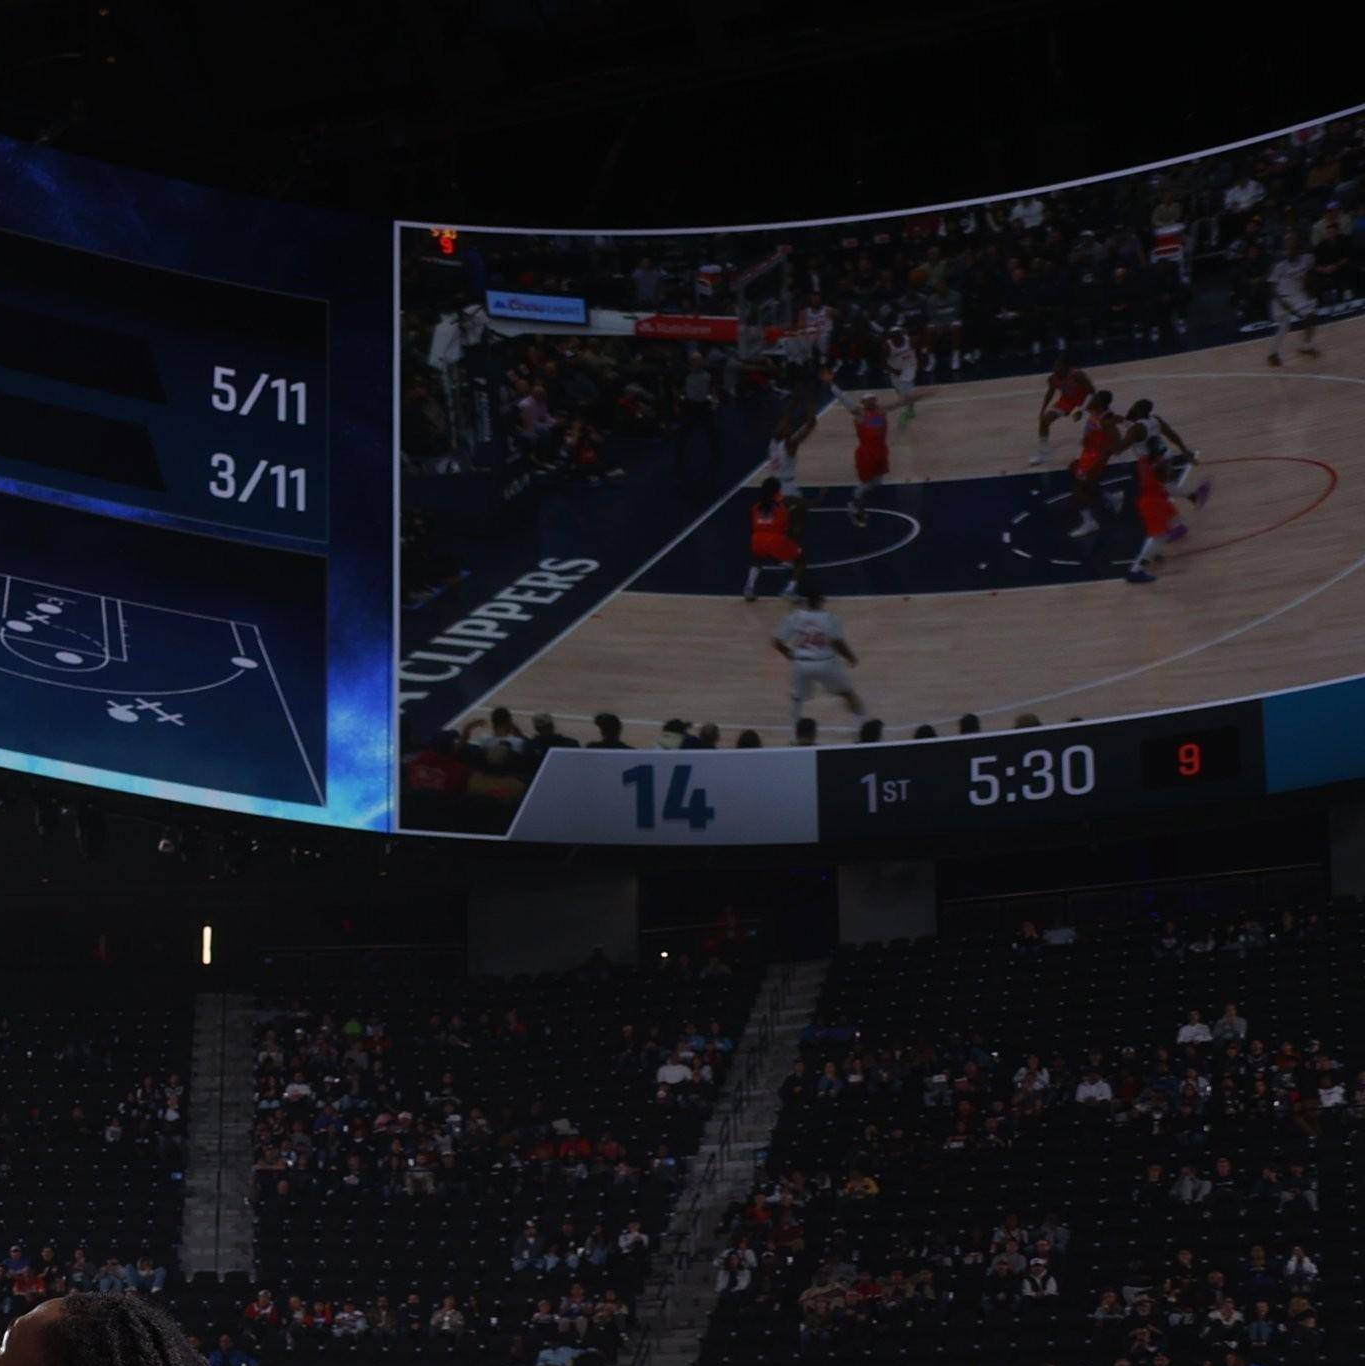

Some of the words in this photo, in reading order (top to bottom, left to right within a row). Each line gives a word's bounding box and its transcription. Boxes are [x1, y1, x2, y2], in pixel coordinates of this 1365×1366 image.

[211, 366, 307, 425] 5/11
[209, 453, 307, 512] 3/11
[400, 557, 601, 683] CLIPPERS
[622, 764, 716, 829] 14
[968, 743, 1097, 807] 5:30
[1176, 740, 1204, 778] 9
